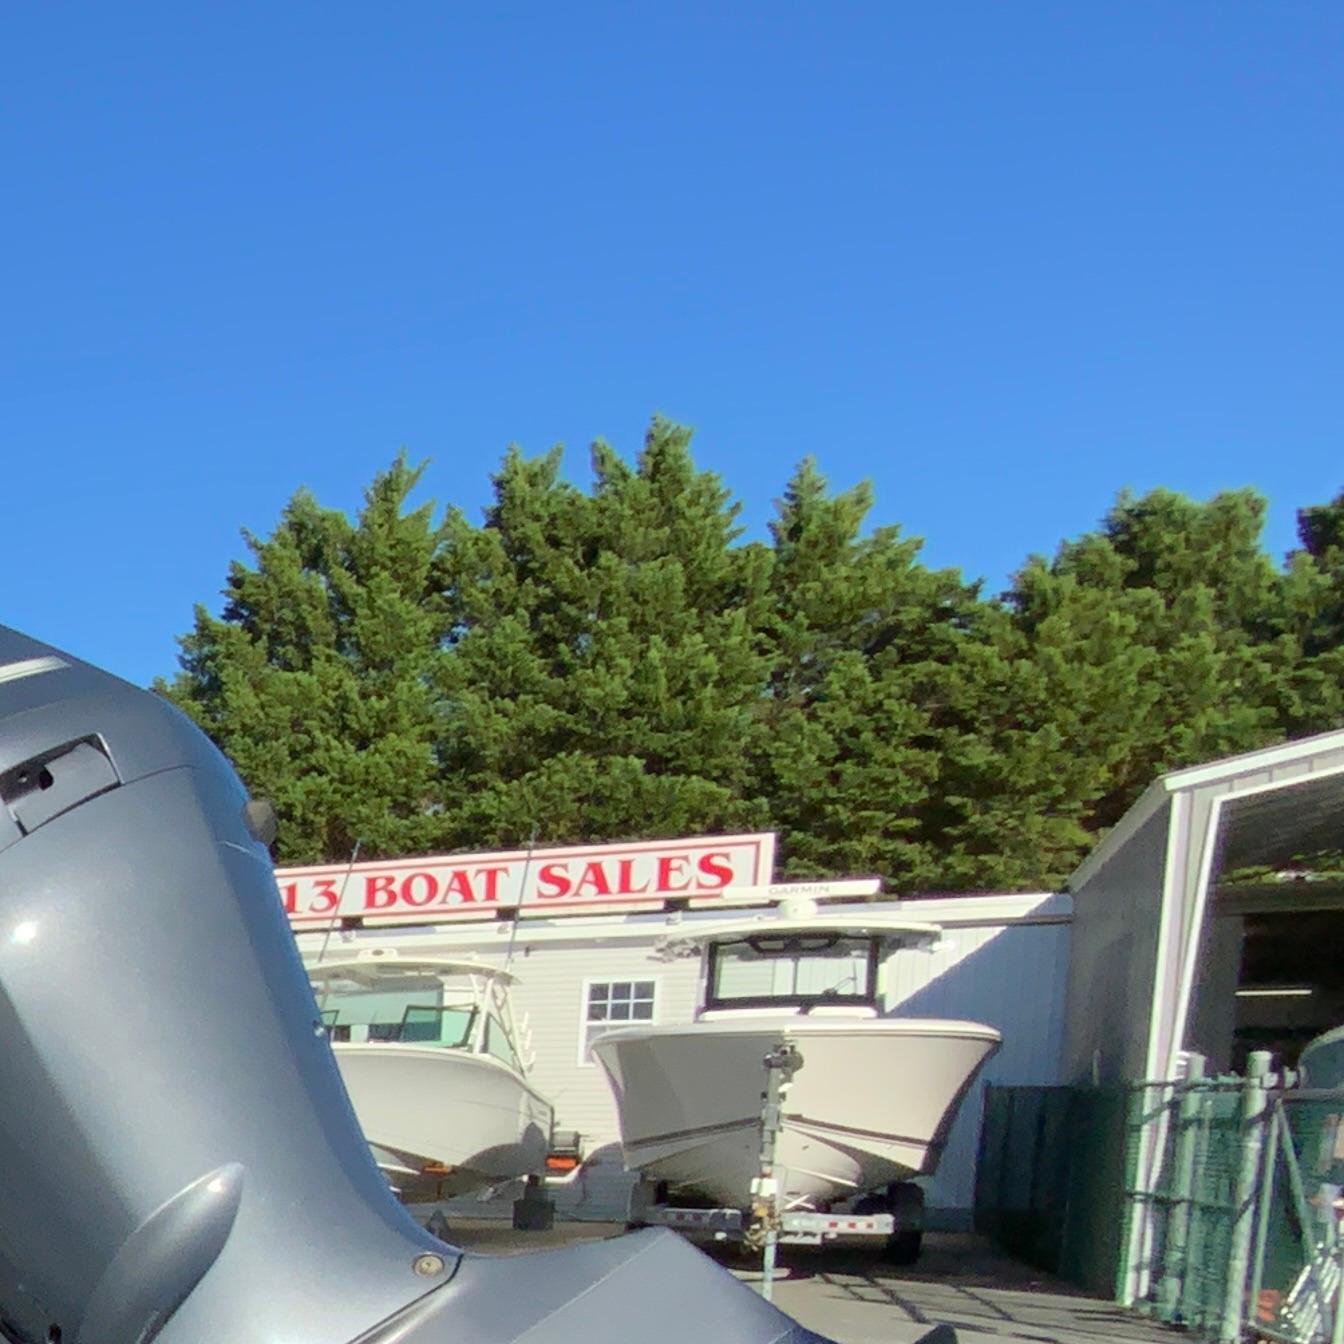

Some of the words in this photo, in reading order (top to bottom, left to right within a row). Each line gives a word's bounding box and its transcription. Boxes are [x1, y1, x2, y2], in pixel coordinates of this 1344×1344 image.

[362, 867, 510, 910] BOAT
[536, 852, 734, 899] SALES
[769, 884, 830, 896] GARMIN
